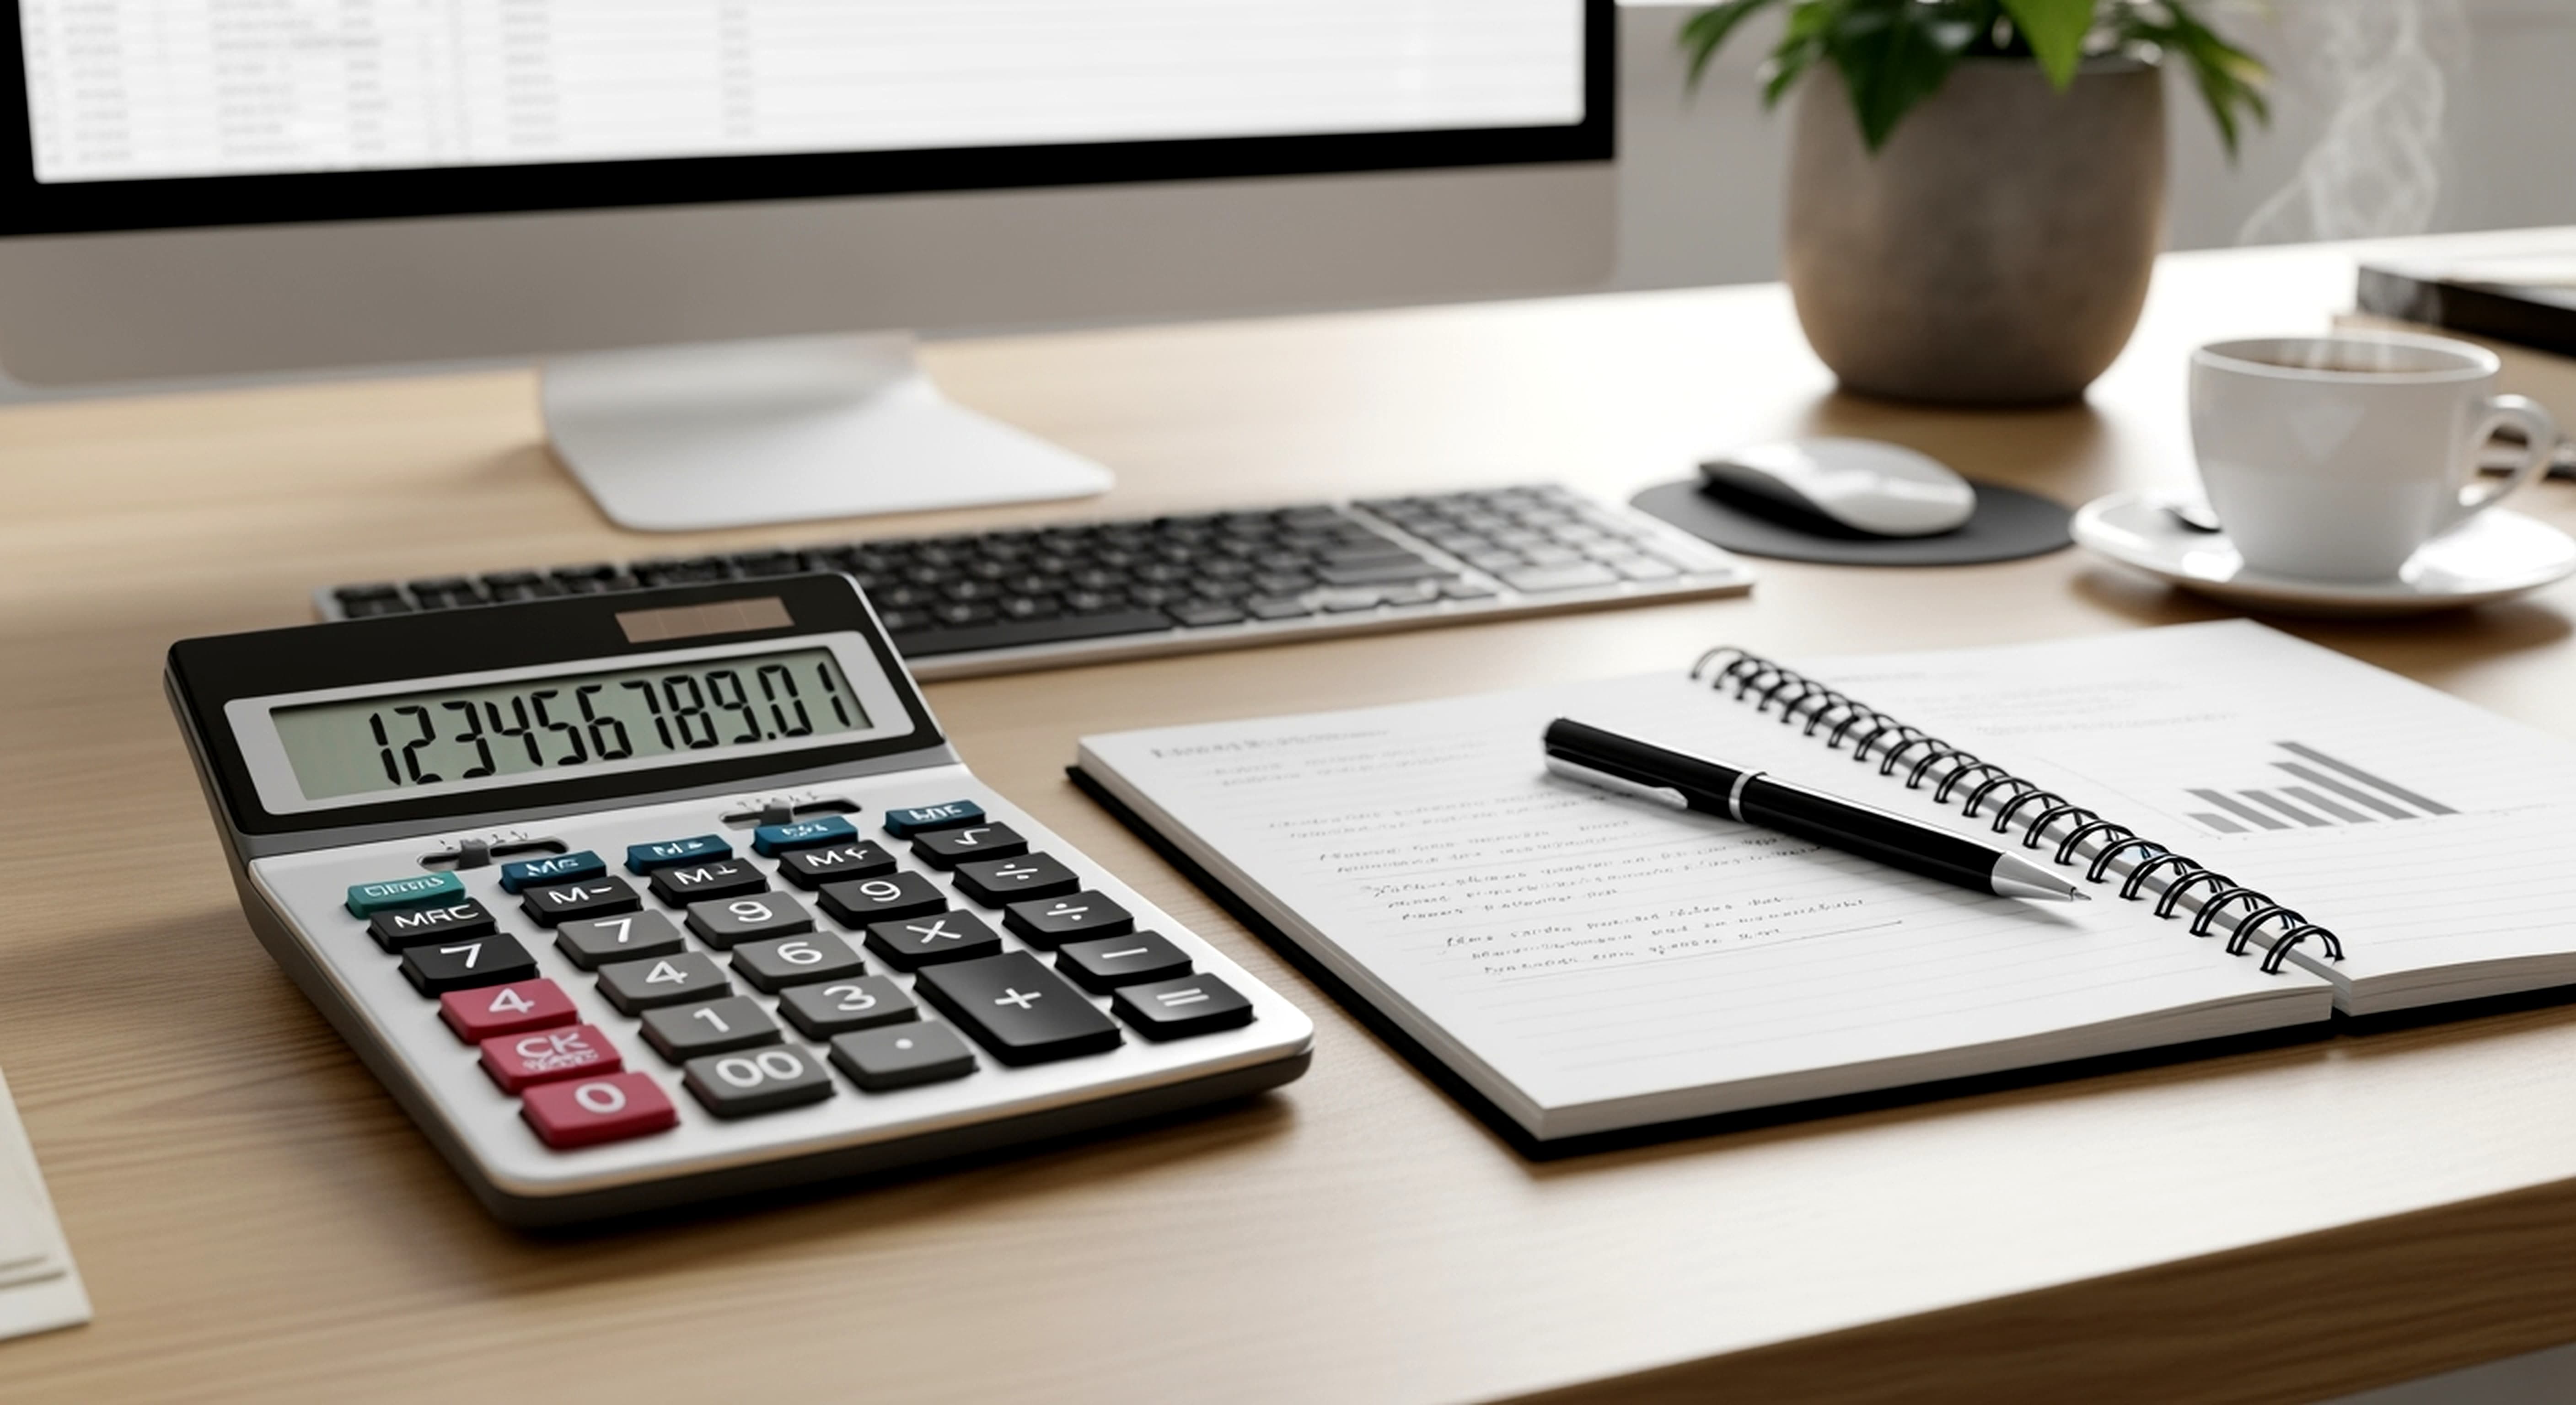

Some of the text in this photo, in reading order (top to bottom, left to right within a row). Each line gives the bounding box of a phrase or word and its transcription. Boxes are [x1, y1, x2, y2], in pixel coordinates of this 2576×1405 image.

[370, 662, 852, 786] 123456789.01
[859, 880, 902, 903] 9
[728, 901, 773, 923] 9
[593, 917, 633, 944] 7
[439, 942, 483, 970] 7
[777, 941, 823, 965] 6
[645, 960, 689, 985] 4
[488, 987, 535, 1014] 4
[822, 984, 877, 1011] 3
[692, 1007, 730, 1033] 1
[714, 1050, 805, 1088] 00
[574, 1082, 627, 1114] 0
